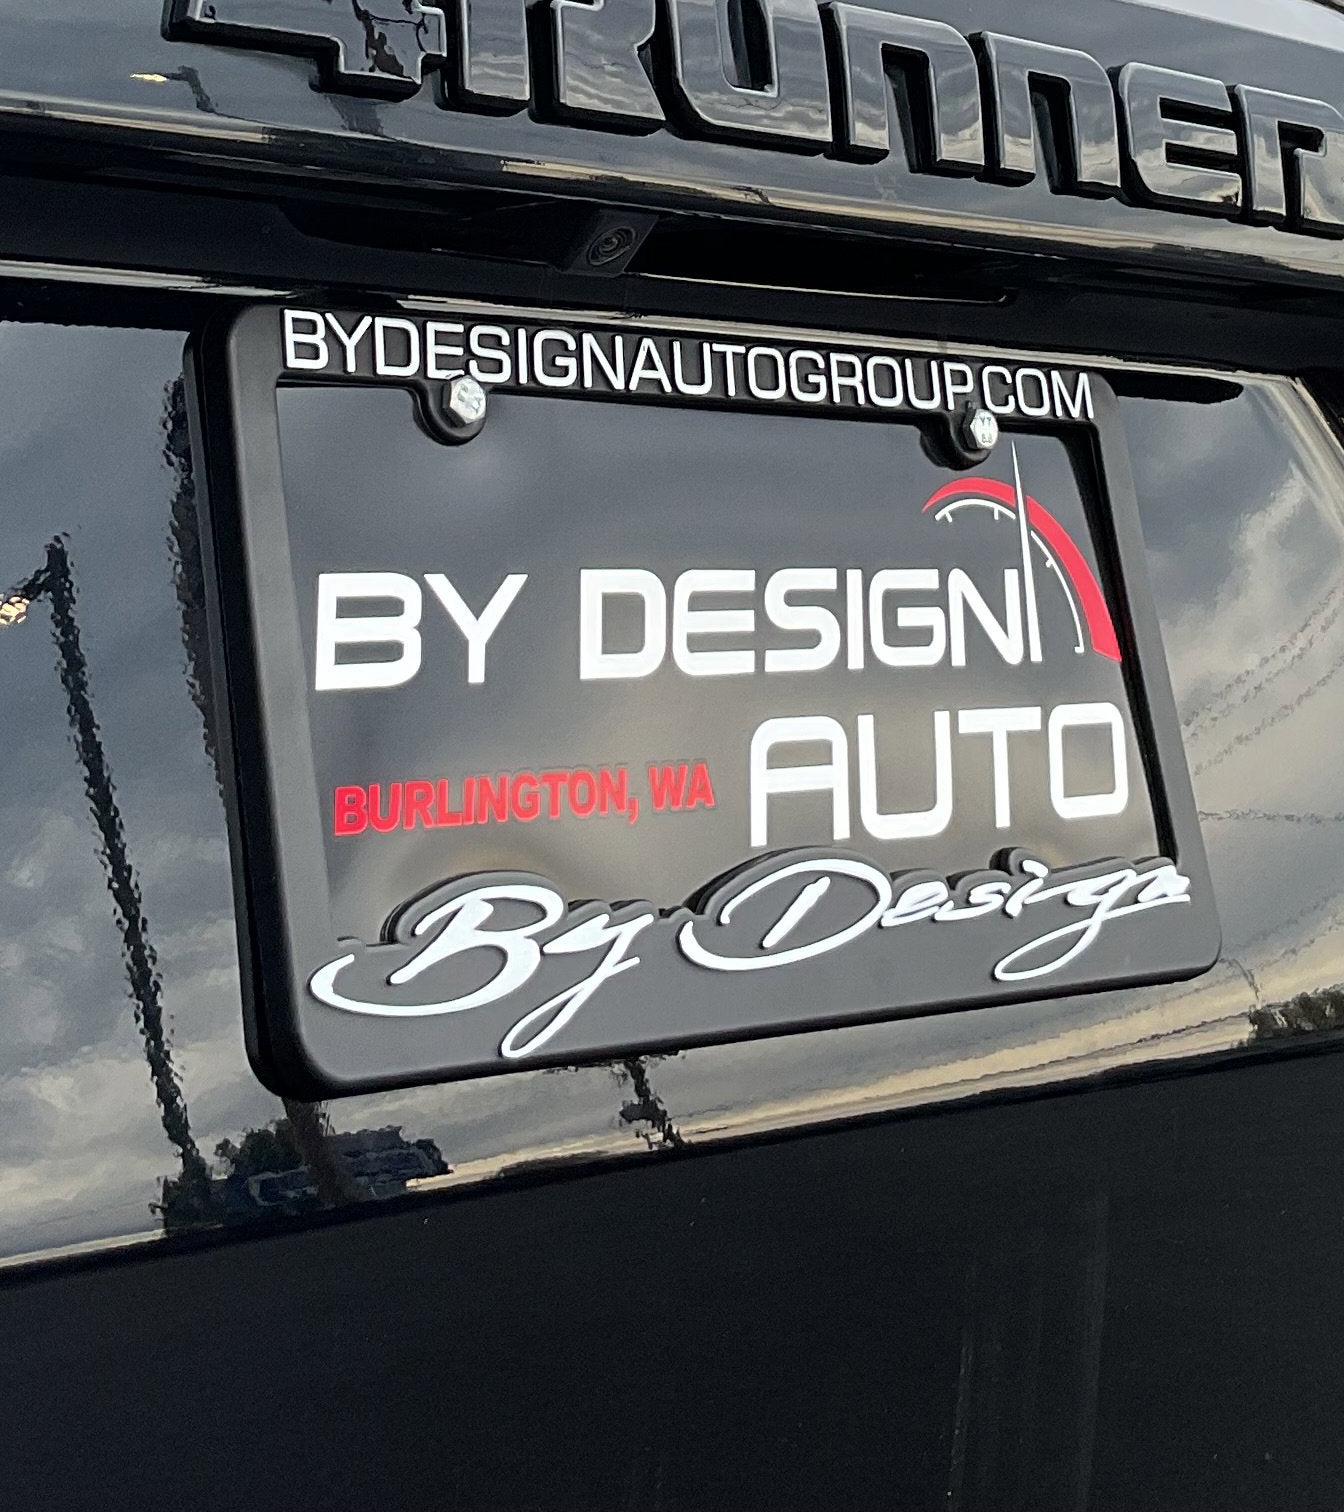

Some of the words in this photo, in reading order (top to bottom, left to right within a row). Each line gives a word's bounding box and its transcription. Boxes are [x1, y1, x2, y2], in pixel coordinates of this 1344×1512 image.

[314, 571, 529, 692] BY
[579, 567, 1025, 681] DESIGN
[332, 766, 640, 837] BURLINGTON,
[647, 761, 716, 812] WA
[748, 701, 1130, 848] AUTO
[309, 883, 655, 1059] By
[679, 857, 1192, 982] Design
